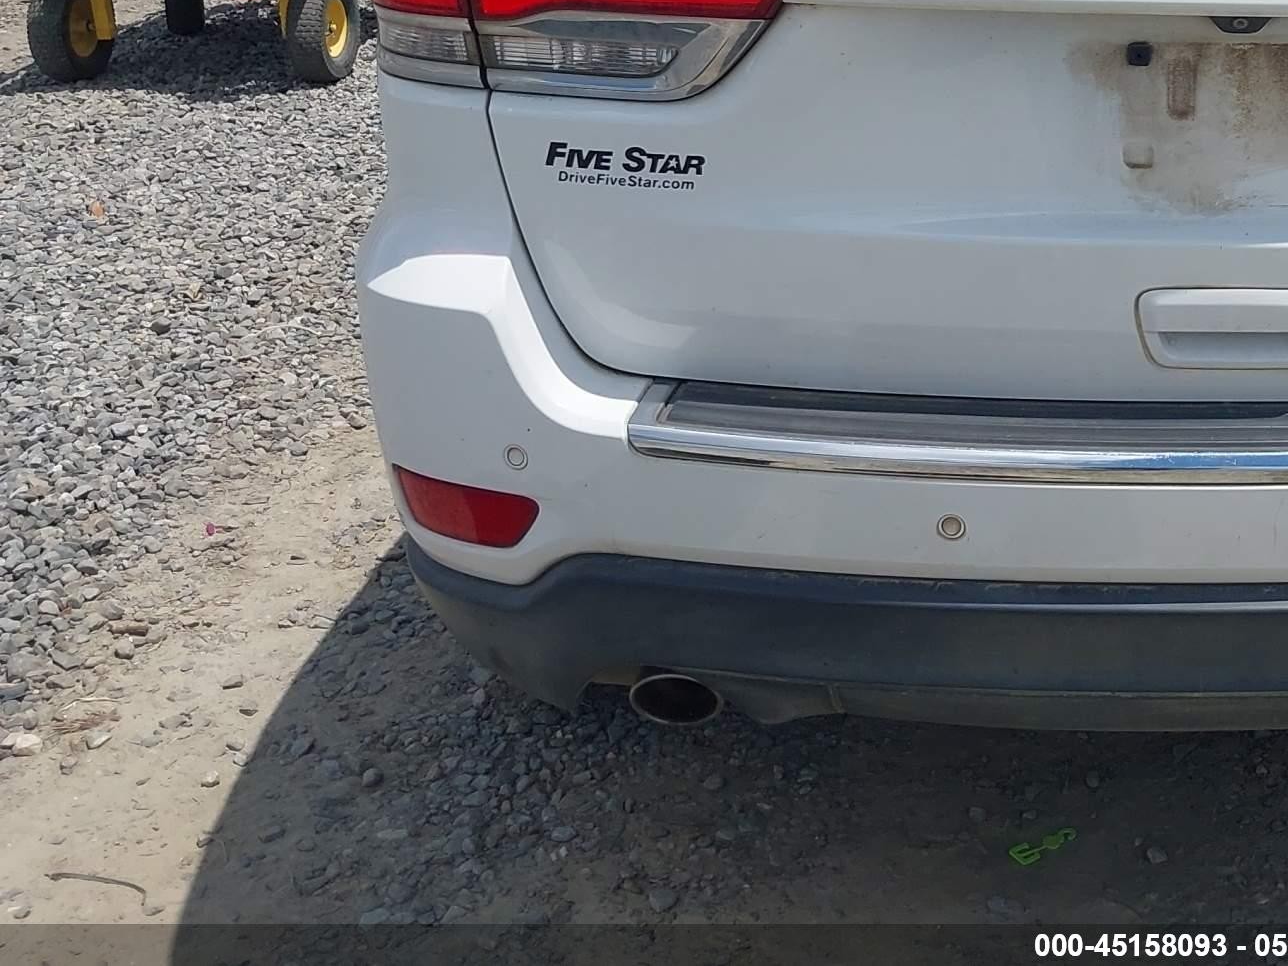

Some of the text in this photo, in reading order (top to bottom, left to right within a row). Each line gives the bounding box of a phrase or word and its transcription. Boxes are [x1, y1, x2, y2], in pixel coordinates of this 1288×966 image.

[545, 141, 706, 176] FIVE STAR
[558, 170, 695, 190] DriveFiveStar.com
